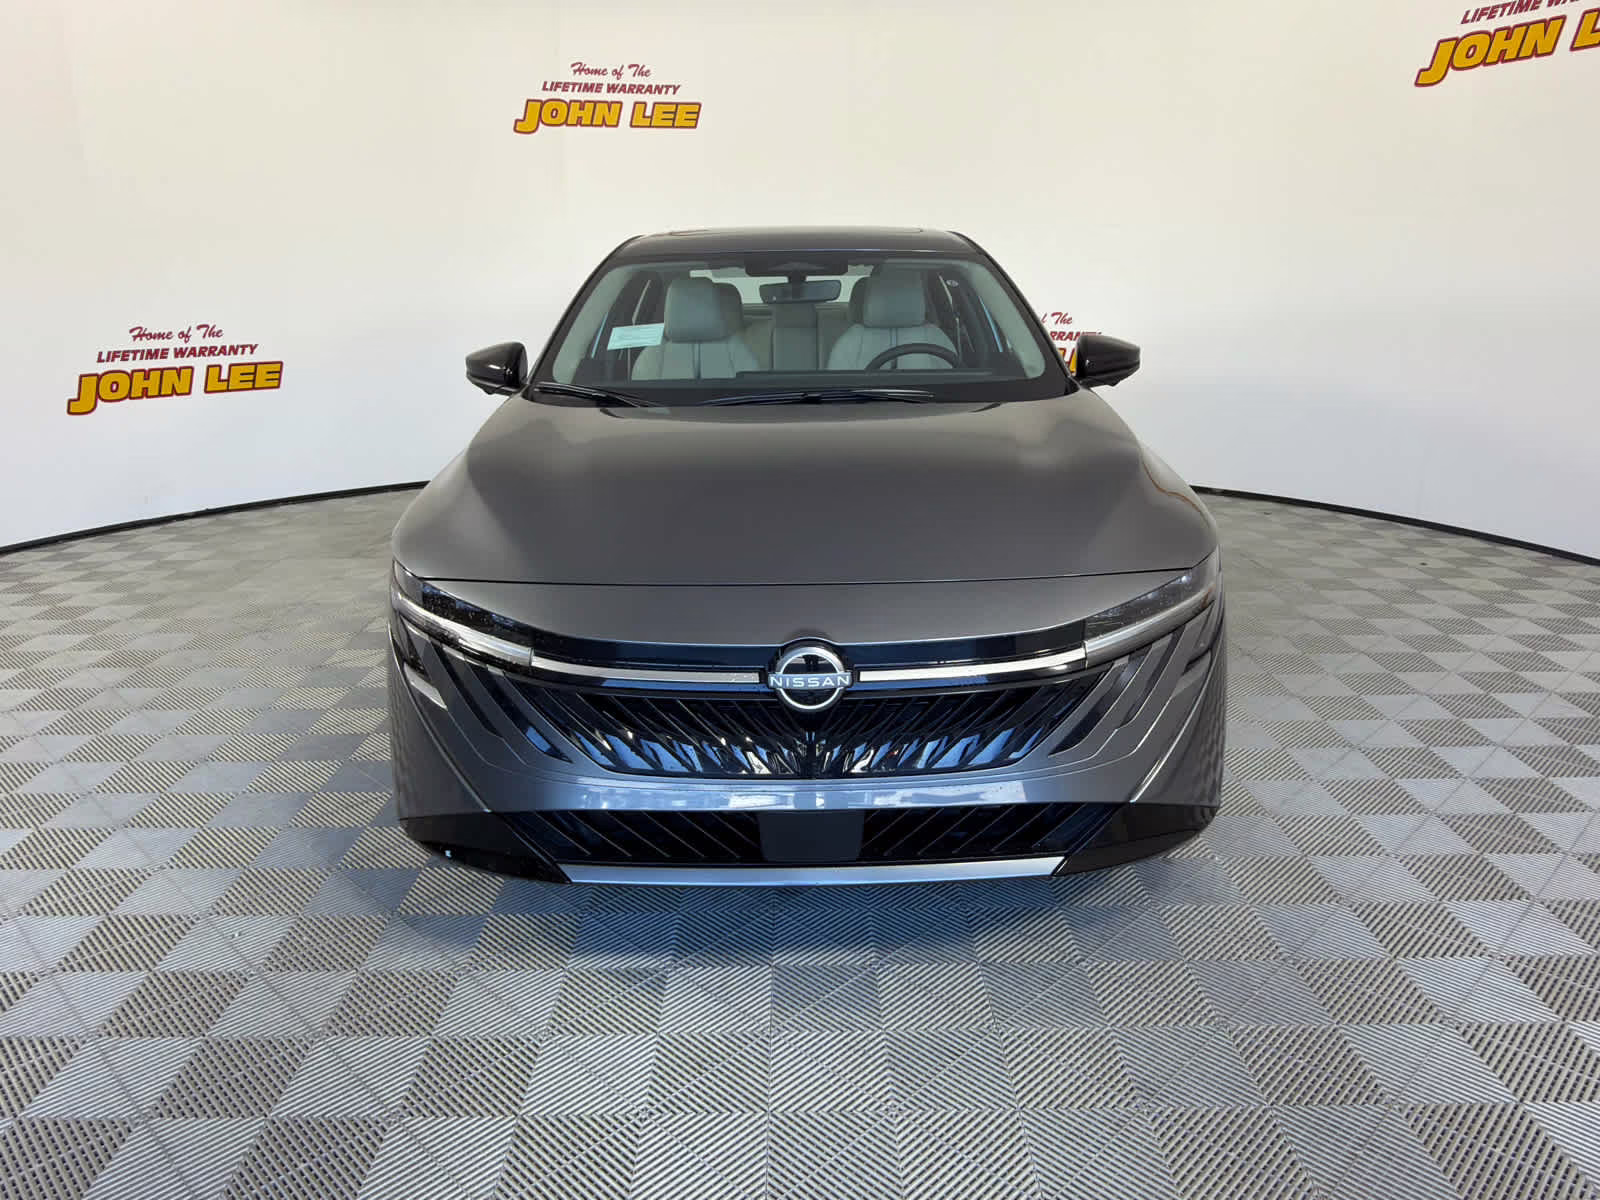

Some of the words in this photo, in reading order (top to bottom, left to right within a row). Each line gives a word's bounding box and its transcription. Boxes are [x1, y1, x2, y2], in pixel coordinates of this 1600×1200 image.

[1460, 0, 1541, 25] LIFETIME
[1414, 15, 1567, 87] JOHN
[570, 61, 608, 77] Home
[611, 64, 624, 80] of
[628, 63, 651, 77] The
[541, 81, 603, 93] LIFETIME
[606, 83, 681, 95] WARRANTY
[513, 98, 623, 135] JOHN
[629, 101, 702, 129] LEE
[1051, 312, 1072, 325] The
[129, 326, 173, 342] Home
[177, 327, 191, 343] of
[196, 324, 224, 339] The
[96, 347, 169, 363] LIFETIME
[173, 343, 258, 359] WARRANTY
[67, 365, 194, 415] JOHN
[204, 361, 283, 393] LEE
[769, 675, 850, 688] NISSAN
